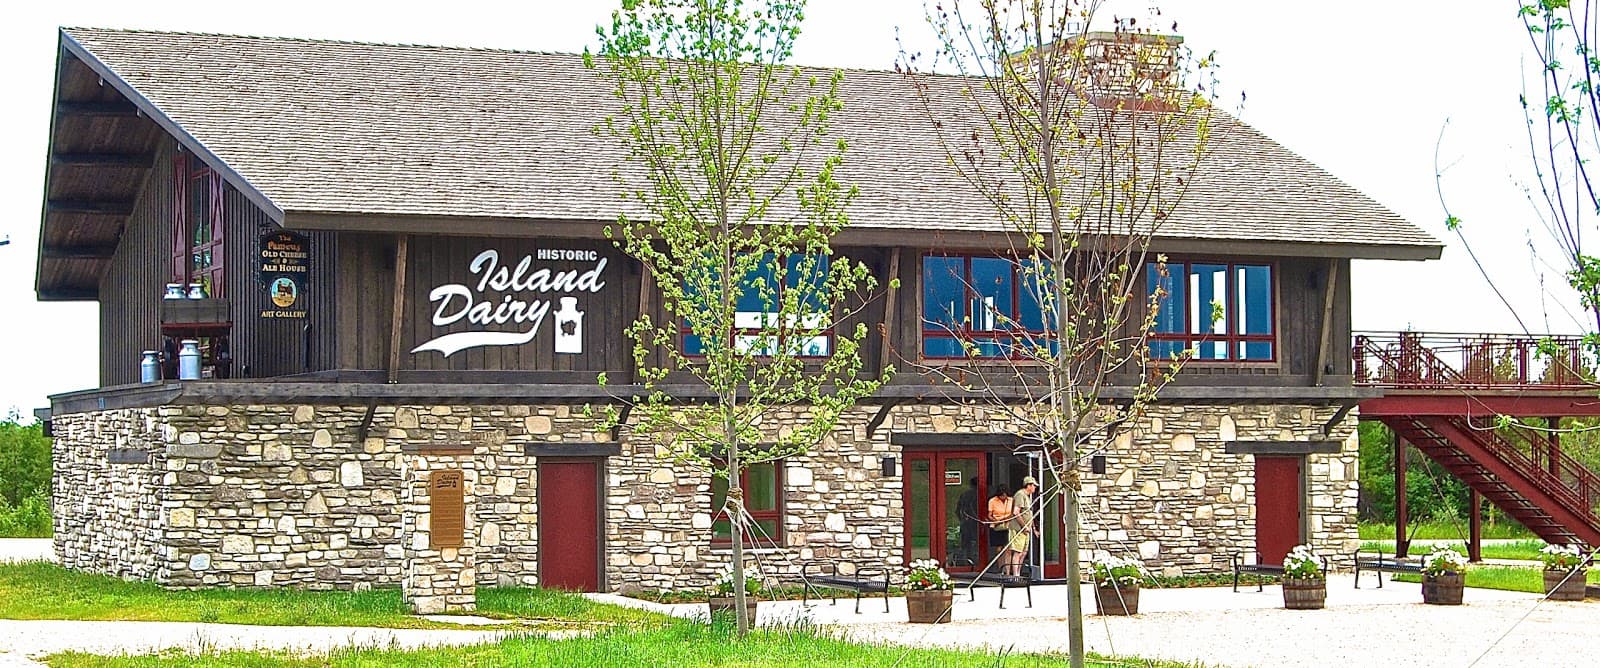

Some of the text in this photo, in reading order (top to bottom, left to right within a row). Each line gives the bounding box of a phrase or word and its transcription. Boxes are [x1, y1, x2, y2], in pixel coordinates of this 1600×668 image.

[262, 250, 307, 259] OLD CHEESE
[537, 249, 598, 261] HISTORIC
[262, 264, 277, 272] ALE
[469, 249, 608, 293] Island
[428, 284, 551, 345] Dairy
